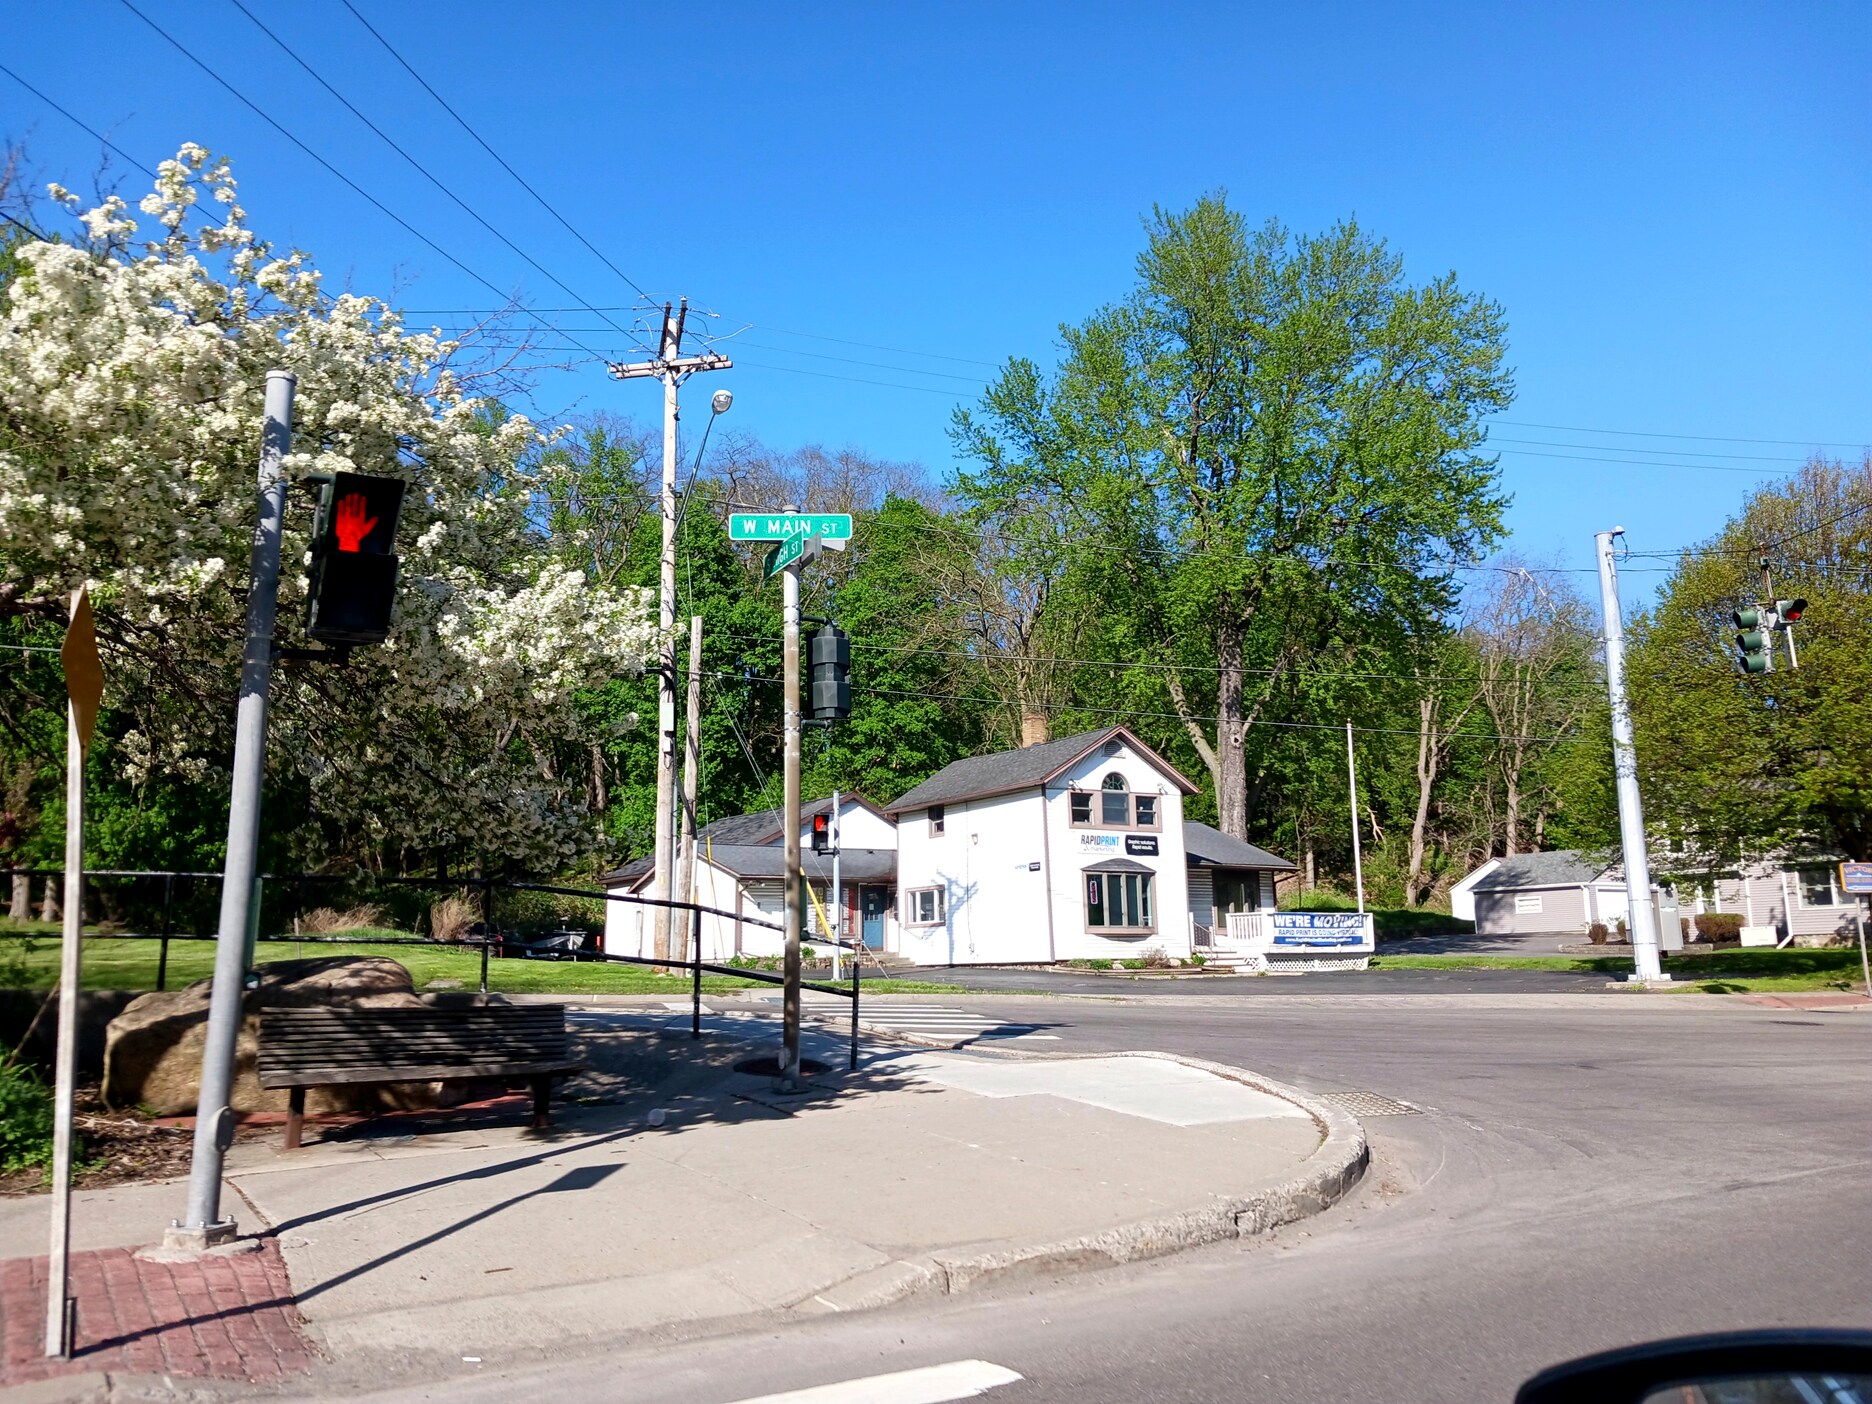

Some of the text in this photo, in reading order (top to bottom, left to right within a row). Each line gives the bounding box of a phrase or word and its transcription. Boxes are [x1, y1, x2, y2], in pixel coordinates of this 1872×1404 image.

[743, 520, 838, 534] W MAIN ST
[791, 541, 799, 555] ST
[1081, 835, 1120, 846] RAPIDPRINT
[1274, 915, 1362, 928] WE'RE MOVING!
